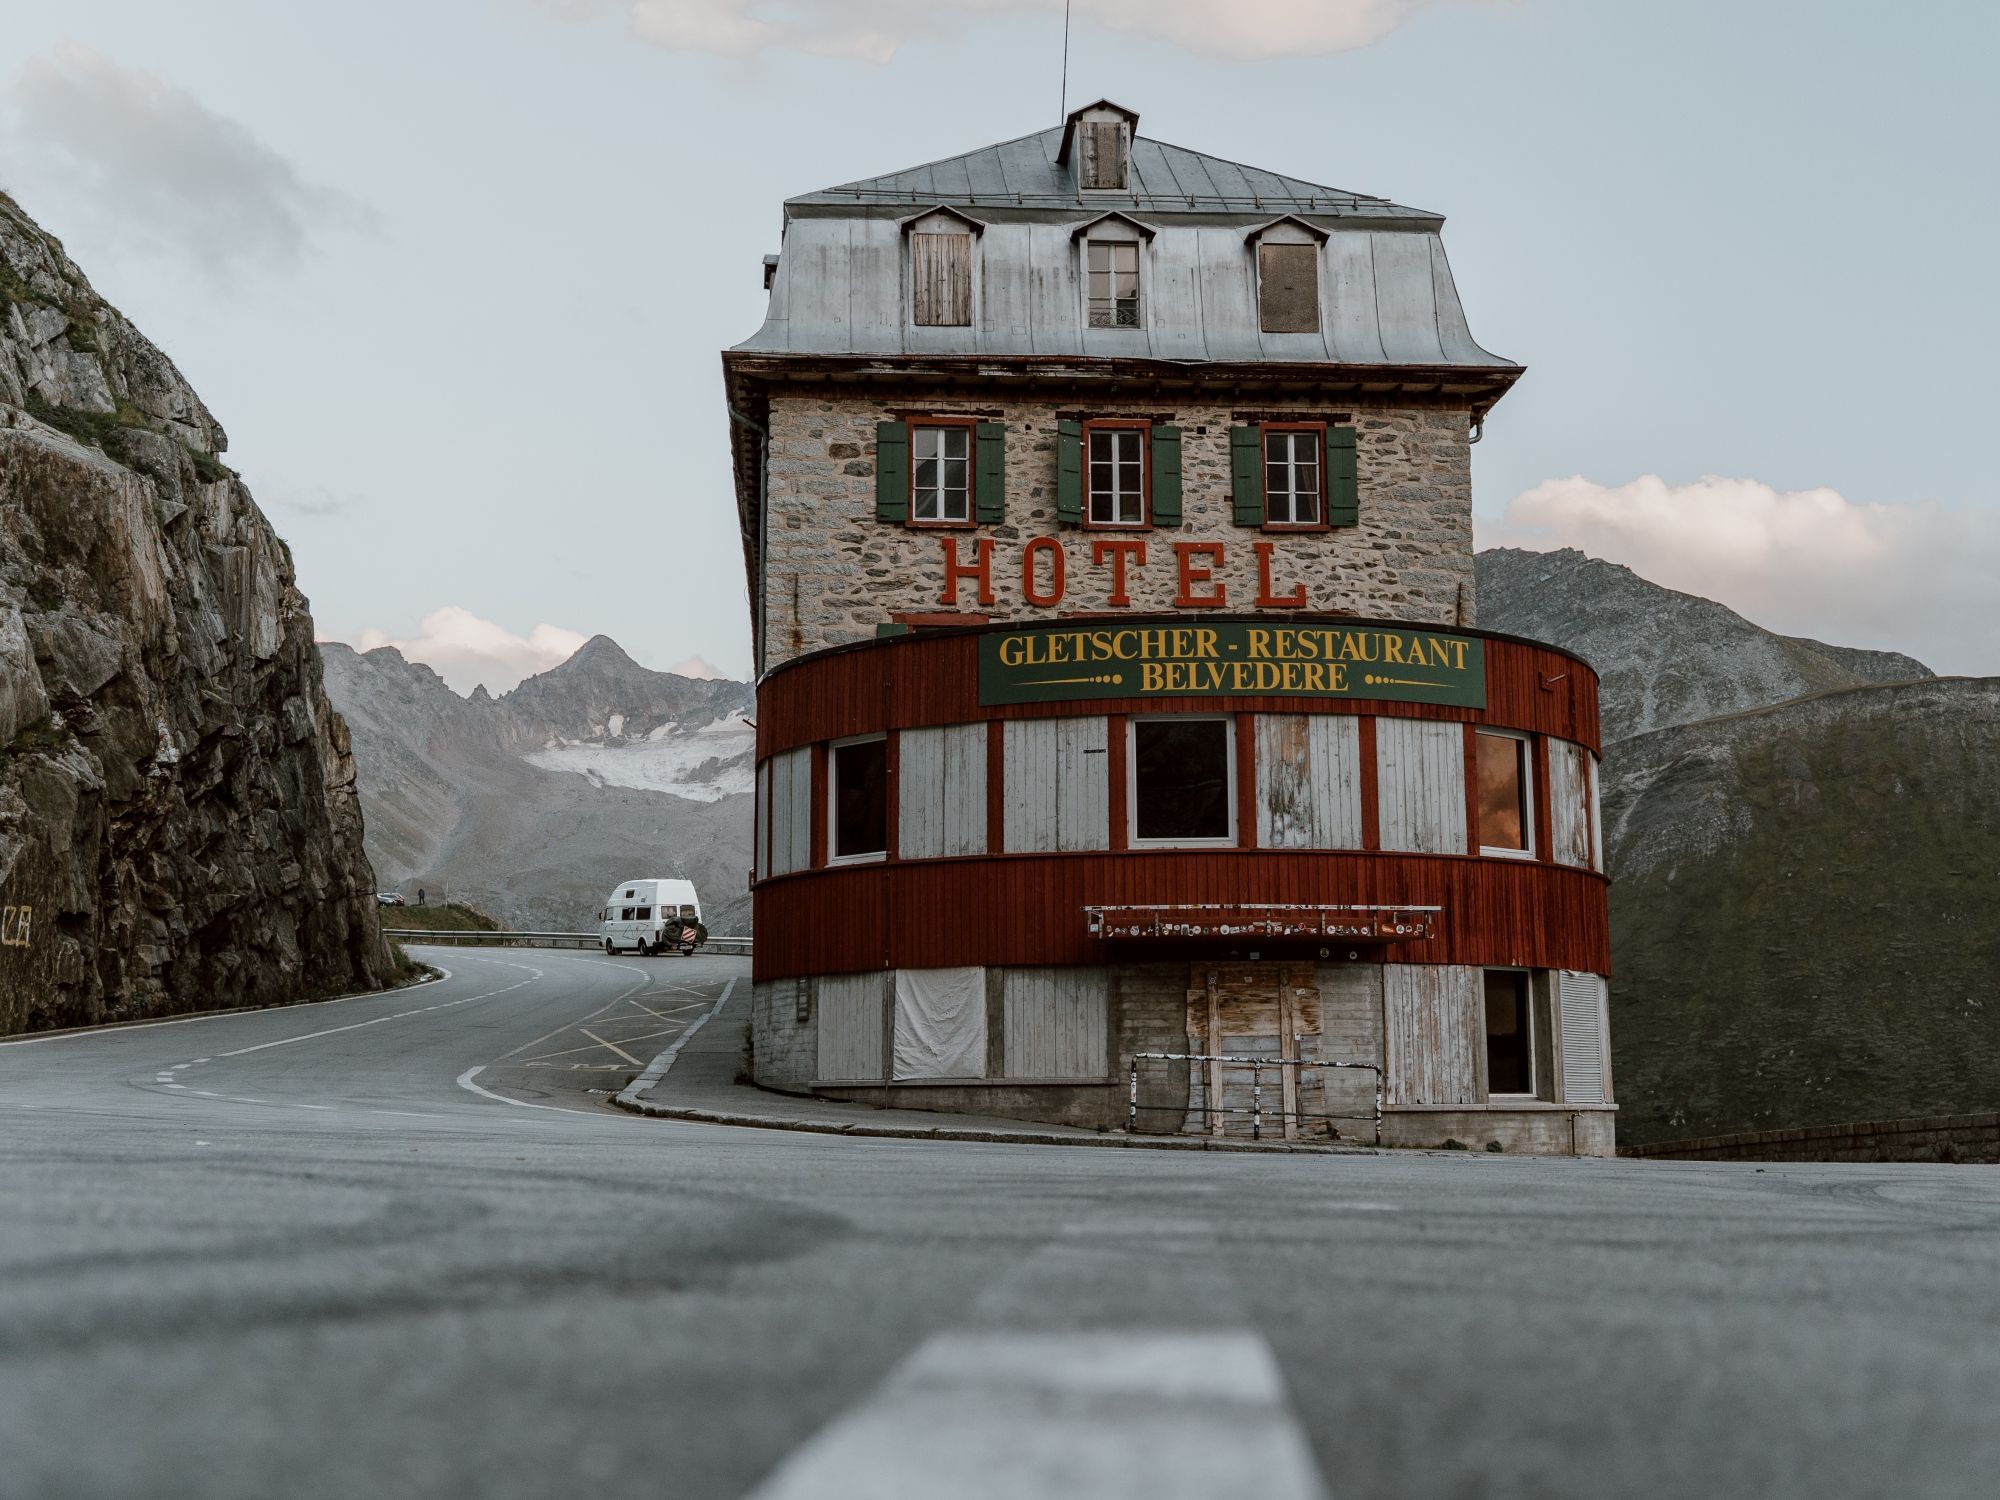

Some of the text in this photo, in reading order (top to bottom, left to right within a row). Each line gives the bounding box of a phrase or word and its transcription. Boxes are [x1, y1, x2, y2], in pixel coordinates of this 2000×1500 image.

[940, 536, 1307, 608] HOTEL
[999, 628, 1220, 667] GLETSCHER
[1247, 629, 1469, 670] RESTAURANT
[1140, 661, 1349, 691] BELVEDERE
